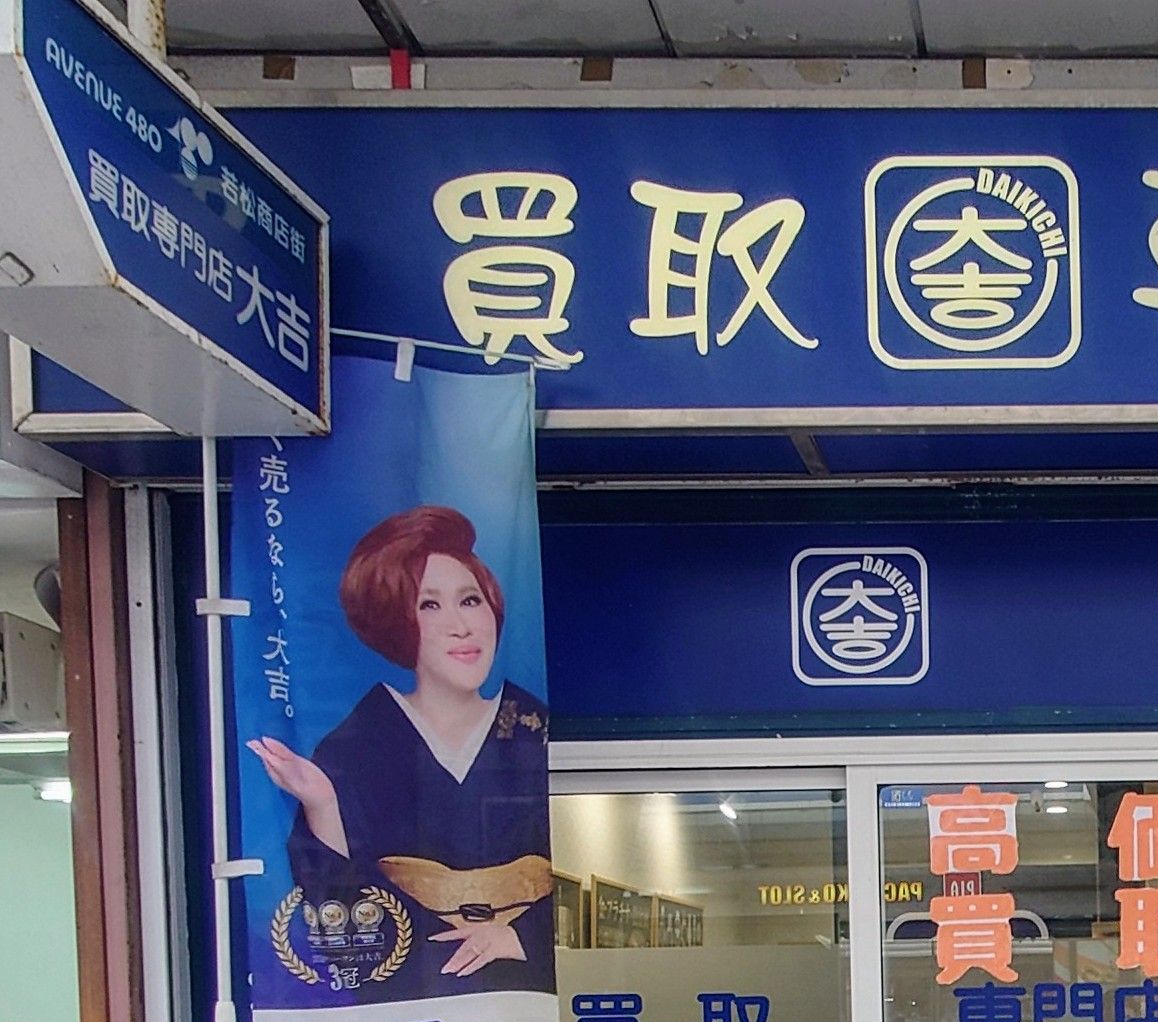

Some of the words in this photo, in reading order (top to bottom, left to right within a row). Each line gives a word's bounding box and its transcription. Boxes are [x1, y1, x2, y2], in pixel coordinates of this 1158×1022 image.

[46, 38, 122, 121] AVENUE
[125, 112, 163, 153] 480
[219, 165, 307, 264] 若松商店街
[976, 166, 1068, 260] DAIKICHI
[432, 171, 819, 366] 買取
[861, 555, 921, 614] DAIKICHI
